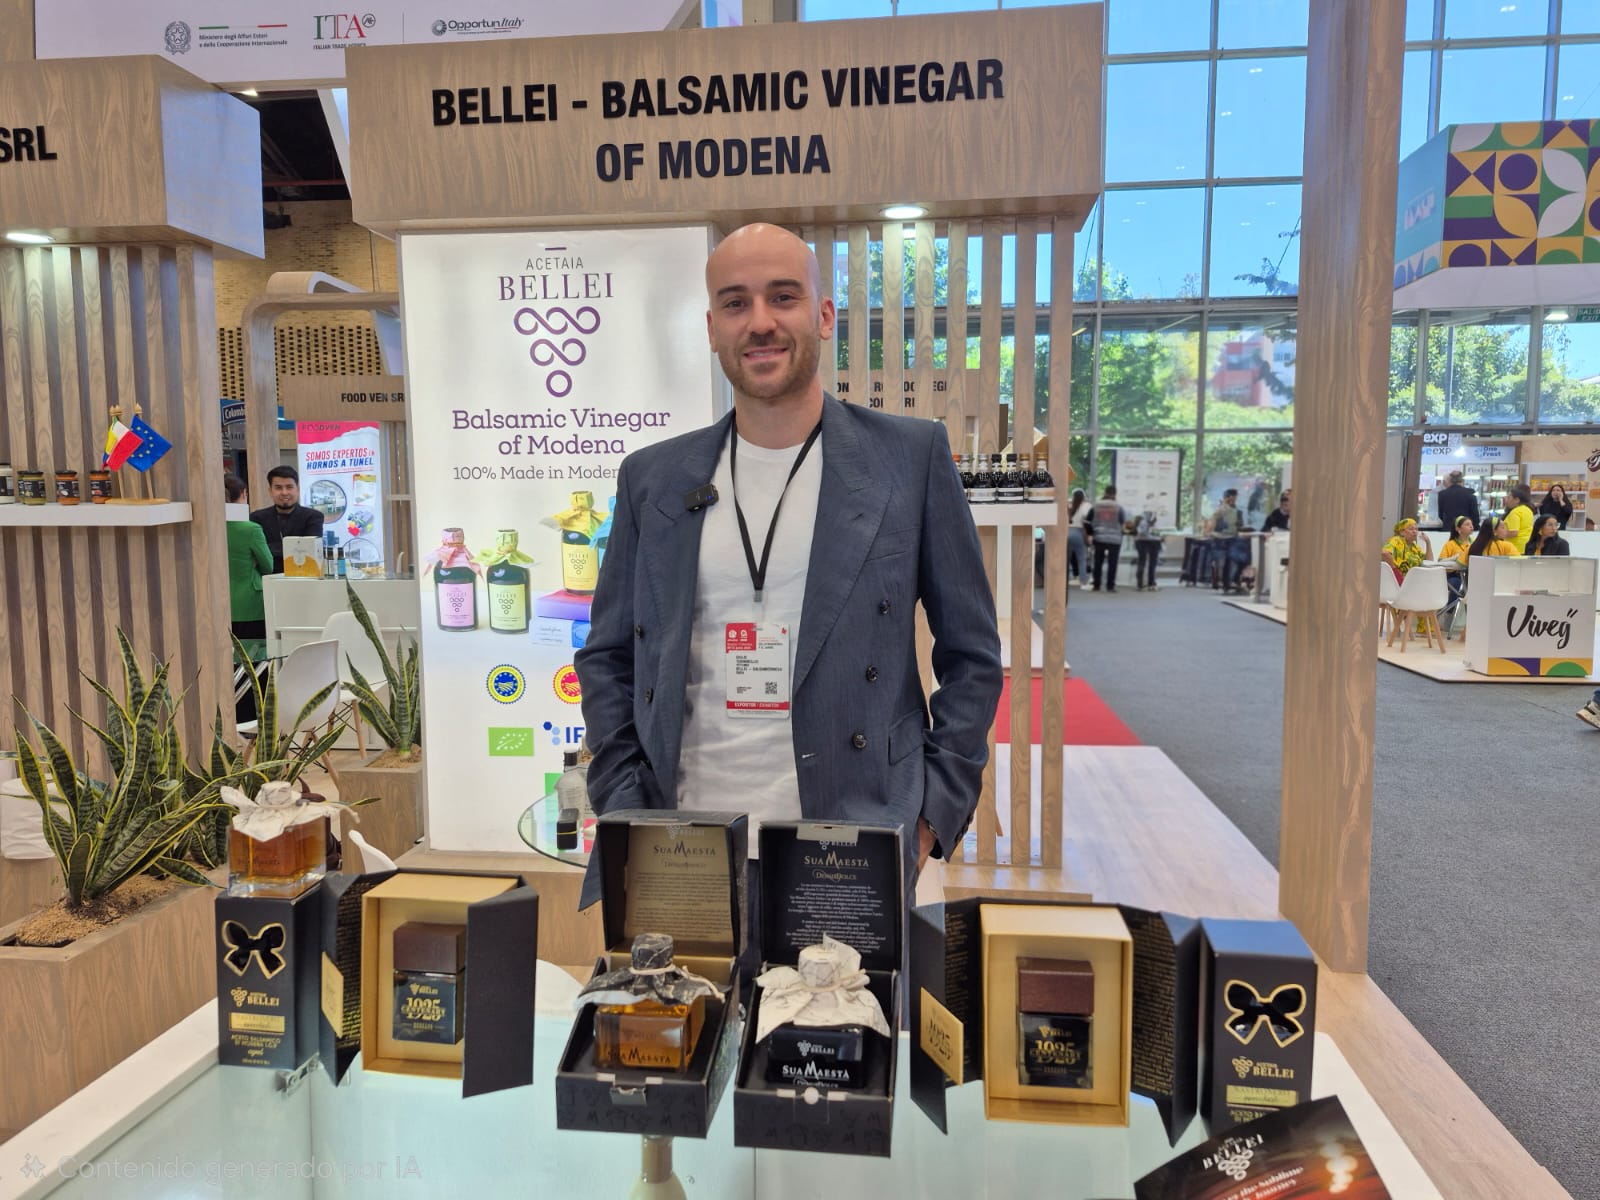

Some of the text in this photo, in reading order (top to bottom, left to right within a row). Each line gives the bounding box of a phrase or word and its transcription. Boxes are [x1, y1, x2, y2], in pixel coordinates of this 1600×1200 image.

[433, 84, 557, 126] BELLEI
[602, 70, 809, 118] BALSAMIC
[822, 58, 1005, 107] VINEGAR
[0, 126, 58, 163] SRL
[596, 134, 831, 182] OF MODENA
[526, 257, 584, 271] ACETAIA
[498, 272, 615, 301] BELLEI
[341, 393, 404, 402] FOOD VEN SR
[452, 408, 671, 432] Balsamic Vinegar
[498, 434, 626, 456] of Modena
[306, 450, 331, 461] SOMOS
[333, 447, 368, 459] EXPERTOS
[306, 460, 338, 470] HORNOS
[341, 459, 347, 467] A
[453, 466, 497, 480] 100%
[500, 465, 545, 480] Made
[549, 465, 563, 479] in
[247, 995, 280, 1007] BELLEI
[1253, 1066, 1294, 1079] BELLEI
